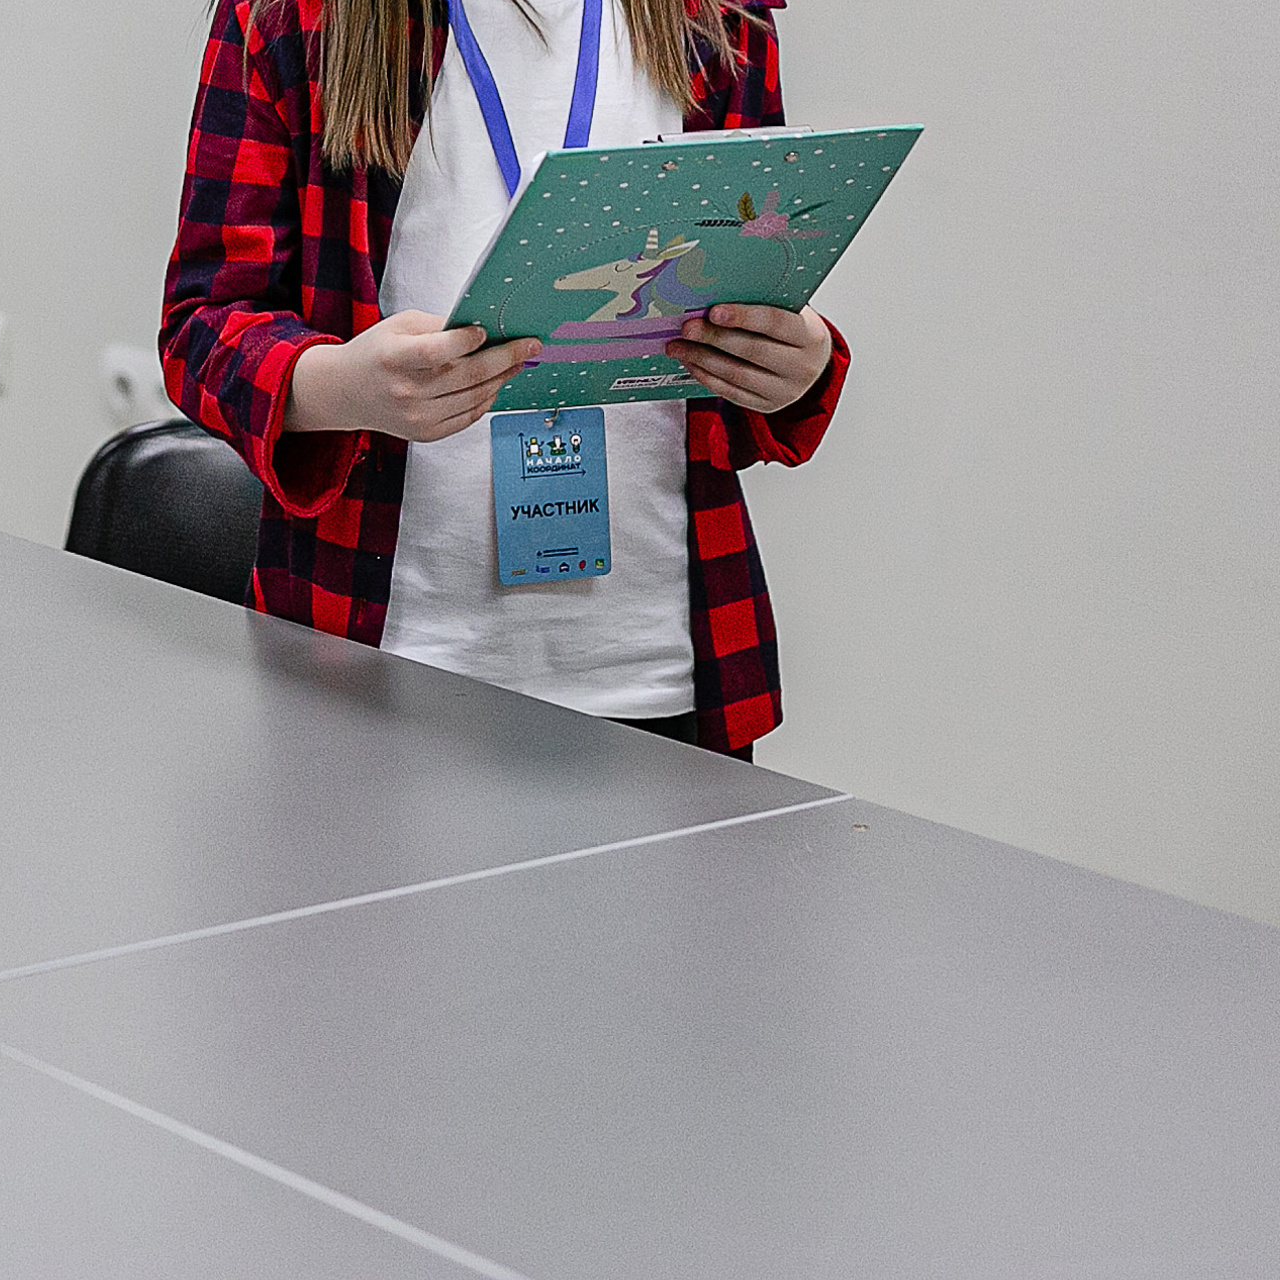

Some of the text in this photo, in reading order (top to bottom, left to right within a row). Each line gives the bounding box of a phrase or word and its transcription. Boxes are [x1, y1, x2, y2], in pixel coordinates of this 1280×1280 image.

[526, 455, 581, 466] НАЧАЛО
[527, 463, 581, 473] КООРДИНАТ
[511, 498, 600, 520] УЧАСТНИК
